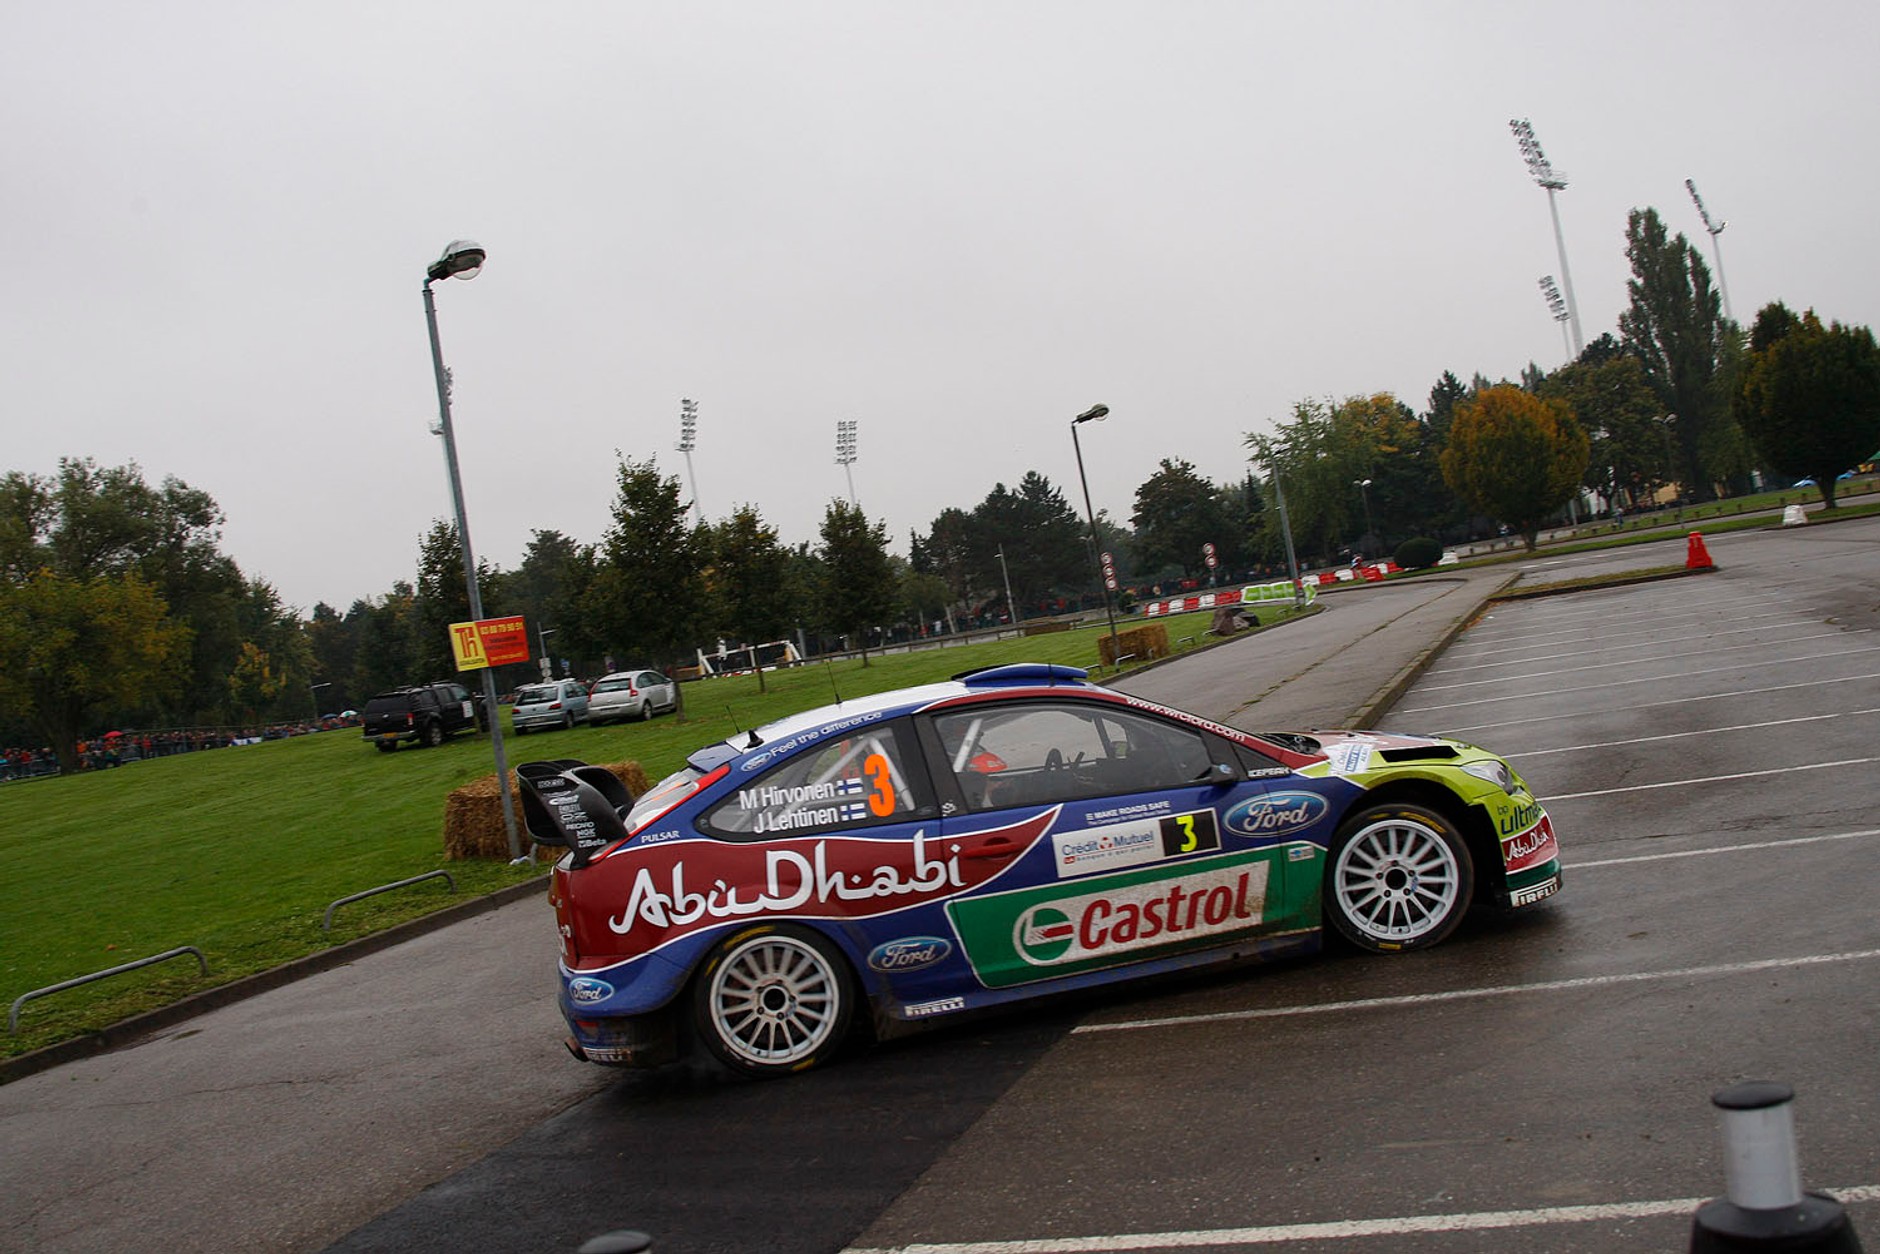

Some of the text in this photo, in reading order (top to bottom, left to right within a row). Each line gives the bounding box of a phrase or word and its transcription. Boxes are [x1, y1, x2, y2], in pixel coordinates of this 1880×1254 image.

[770, 711, 882, 757] Feel the difference
[863, 753, 895, 817] 3
[1248, 767, 1292, 778] ICEPEAK
[739, 781, 835, 811] M Hirvonen
[1118, 804, 1148, 815] ROADS
[1148, 800, 1171, 811] SAFE
[753, 805, 839, 834] J Lehtinen
[1243, 797, 1309, 831] Ford
[641, 829, 681, 844] PULSAR
[1113, 830, 1154, 848] Mutuel
[1176, 815, 1198, 852] 3
[608, 829, 968, 935] Abu Dhabi
[1510, 876, 1558, 908] PIRELLI
[1079, 872, 1250, 950] Castrol
[881, 942, 936, 968] Ford
[573, 981, 602, 1000] Ford
[904, 996, 965, 1017] PIRELLI
